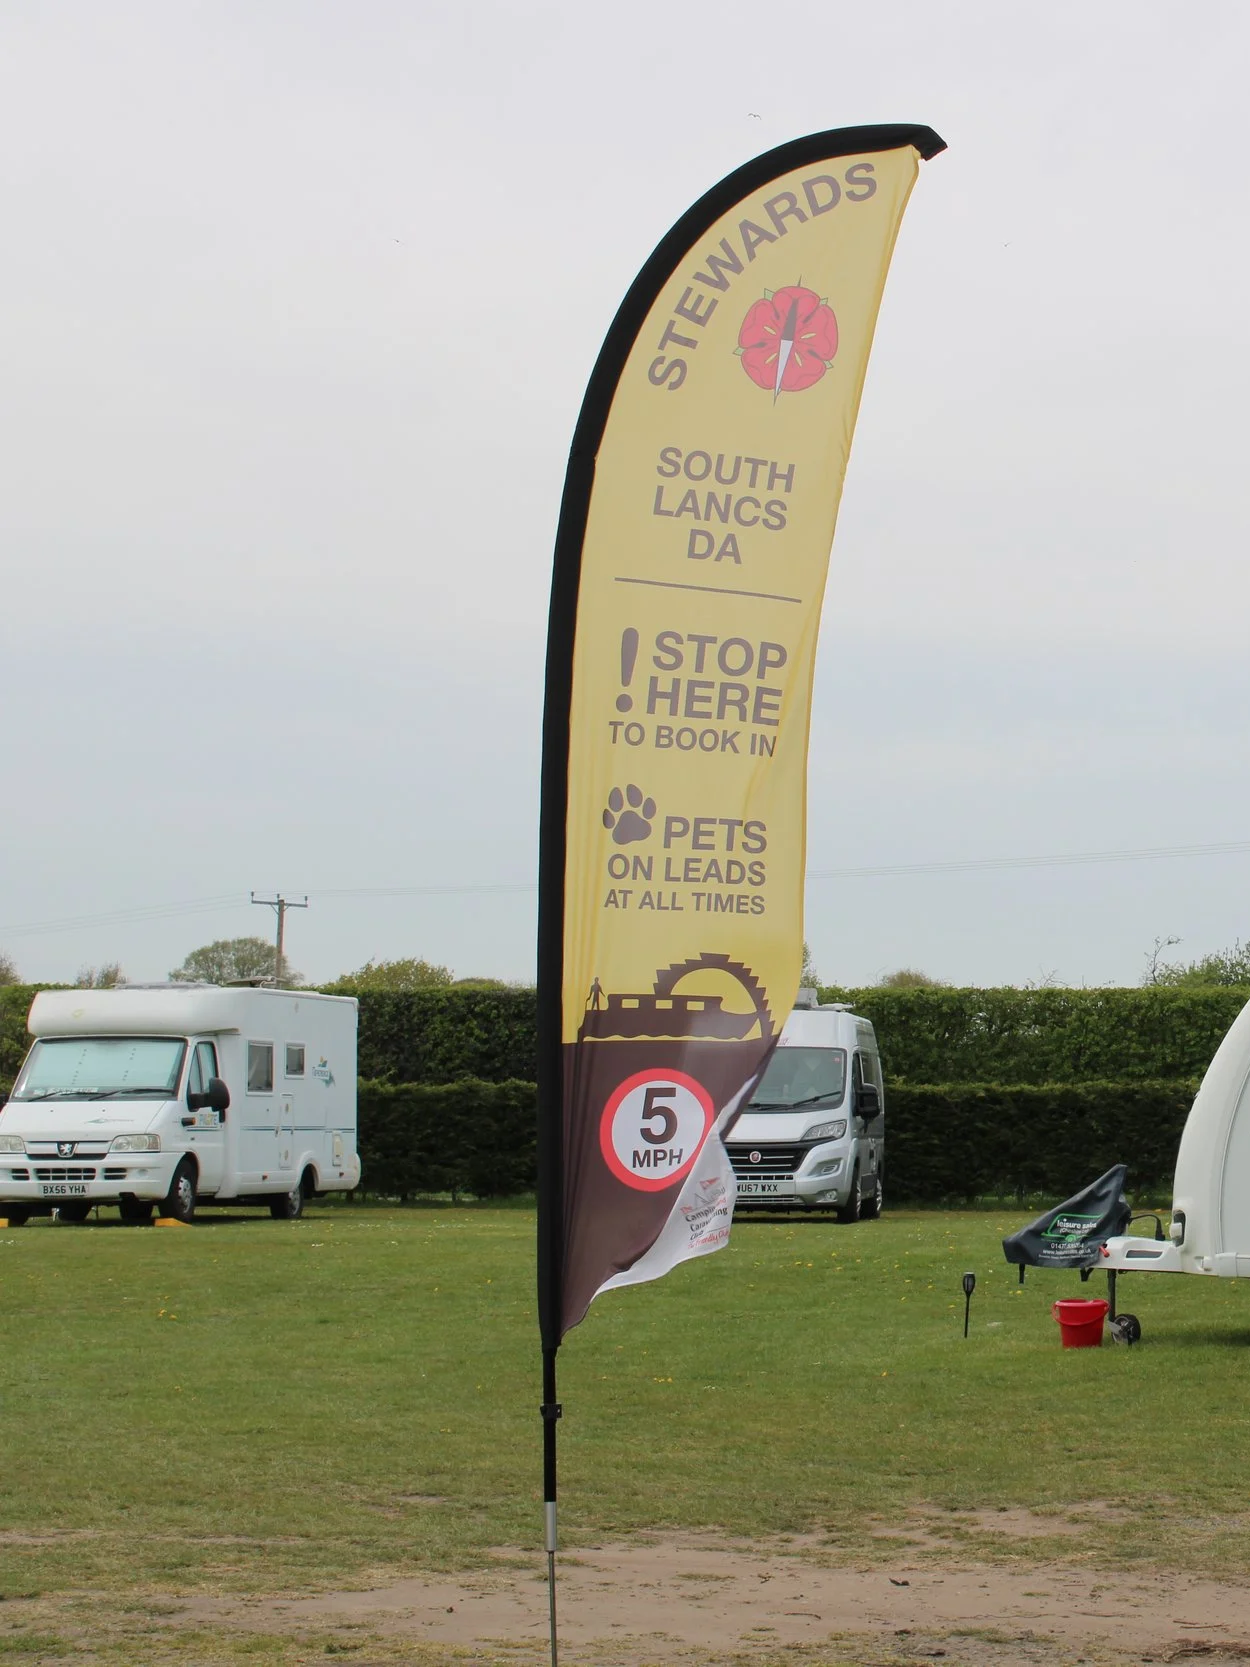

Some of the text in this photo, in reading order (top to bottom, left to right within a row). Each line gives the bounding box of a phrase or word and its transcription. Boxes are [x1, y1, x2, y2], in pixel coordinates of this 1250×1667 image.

[648, 163, 877, 390] STEWARDS
[656, 447, 795, 493] SOUTH
[653, 485, 788, 531] LANCS
[687, 529, 742, 565] DA
[652, 631, 788, 680] STOP
[646, 676, 783, 726] HERE
[608, 721, 777, 757] TO BOOK IN
[663, 816, 768, 854] PETS
[608, 854, 766, 886] ON LEADS
[604, 889, 766, 915] AT ALL TIMES
[640, 1087, 678, 1144] 5
[632, 1148, 684, 1168] MPH
[43, 1185, 87, 1194] BX56 YHA
[761, 1183, 778, 1192] WXX
